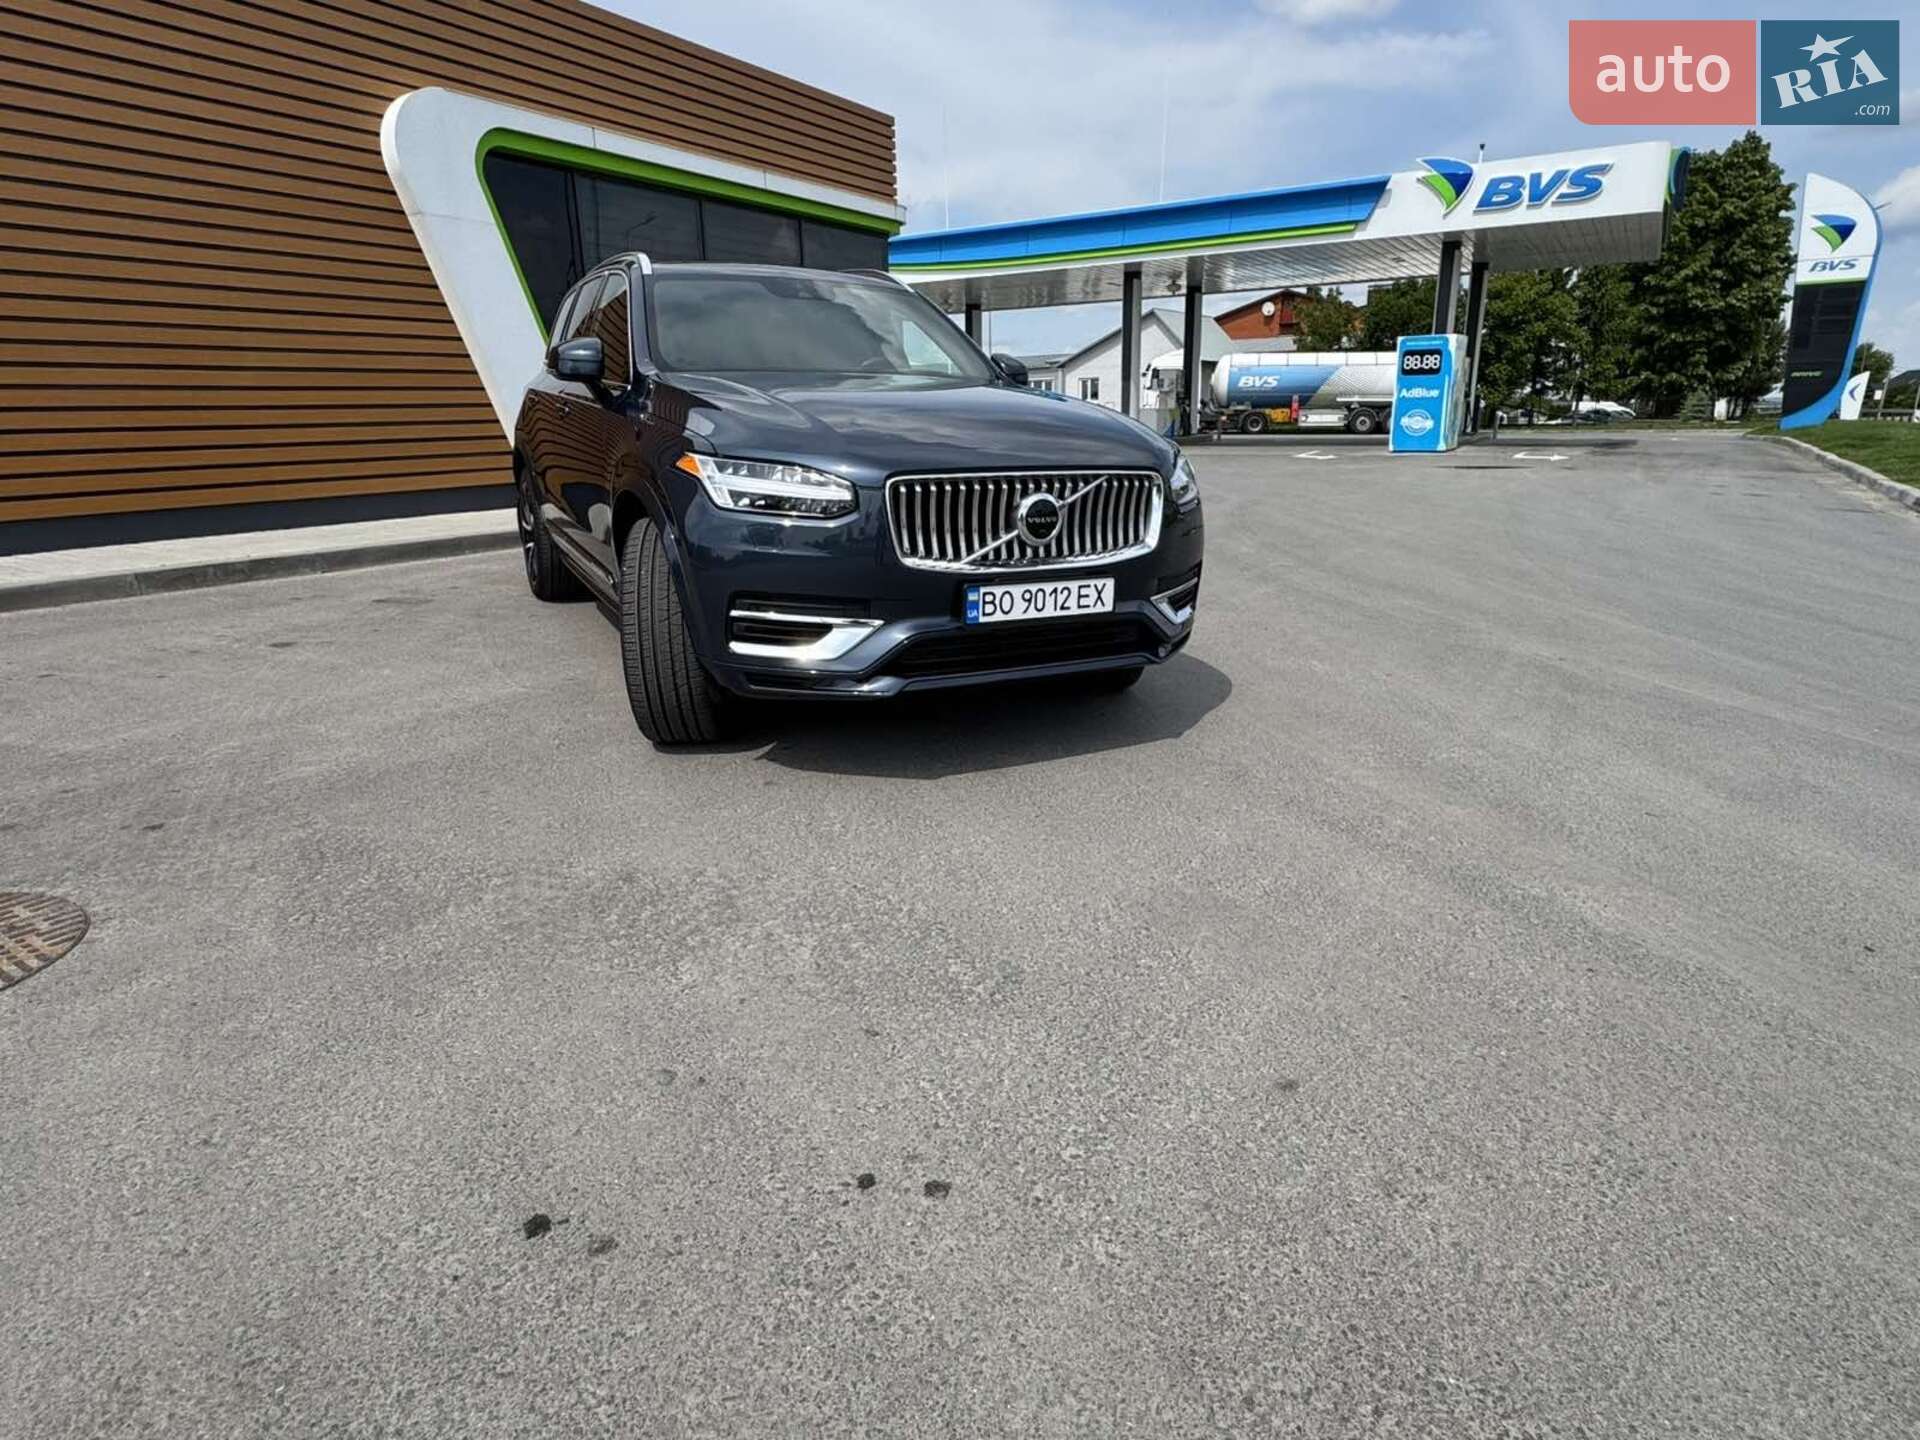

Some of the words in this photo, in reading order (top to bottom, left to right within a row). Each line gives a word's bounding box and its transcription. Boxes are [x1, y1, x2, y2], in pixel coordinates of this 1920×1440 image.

[1473, 162, 1614, 214] BVS
[1809, 259, 1859, 273] BVS
[1238, 375, 1280, 388] BVS
[1399, 387, 1440, 398] AdBlue
[981, 590, 1014, 617] BO
[1021, 586, 1072, 615] 9012
[1077, 583, 1107, 609] EX
